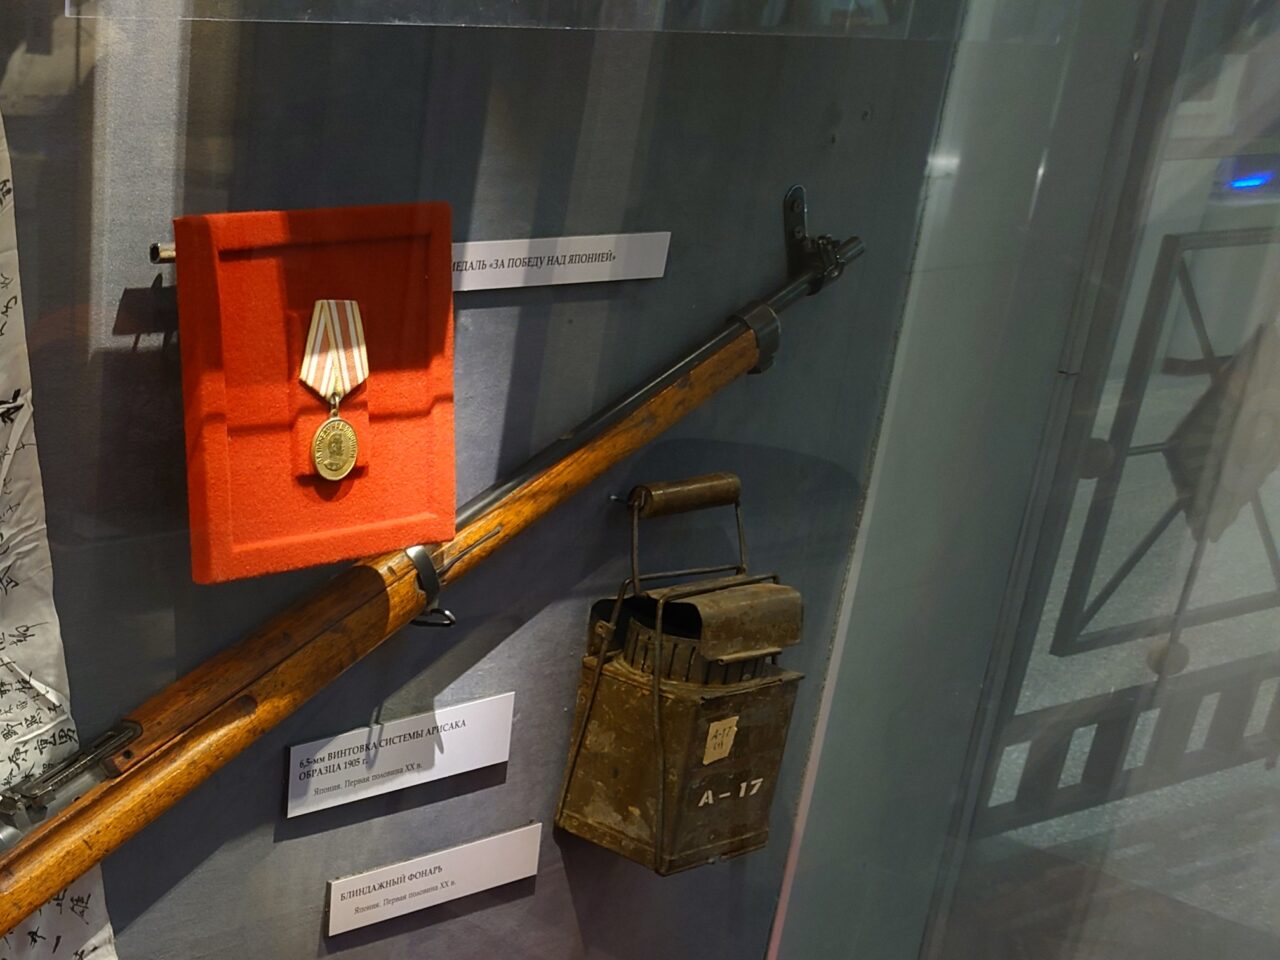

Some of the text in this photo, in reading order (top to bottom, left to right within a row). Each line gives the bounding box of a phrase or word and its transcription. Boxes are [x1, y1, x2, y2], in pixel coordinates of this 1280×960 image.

[507, 256, 546, 269] ПОБЕДУ
[547, 254, 566, 266] НАД
[568, 249, 616, 264] ЯПОНИЕЙ»
[327, 742, 377, 761] ВИНТОВКА
[379, 729, 423, 748] СИСТЕМЫ
[425, 719, 466, 737] АРИСАКА
[298, 763, 341, 781] ОБРАЗЦА
[343, 757, 360, 770] 1905
[313, 783, 341, 796] Япония.
[344, 776, 370, 789] Первая
[371, 767, 404, 781] половина
[340, 865, 443, 901] БЛИНДАЖНЫЙ ФОНАРЬ
[383, 895, 407, 906] Первая
[408, 885, 438, 898] половина
